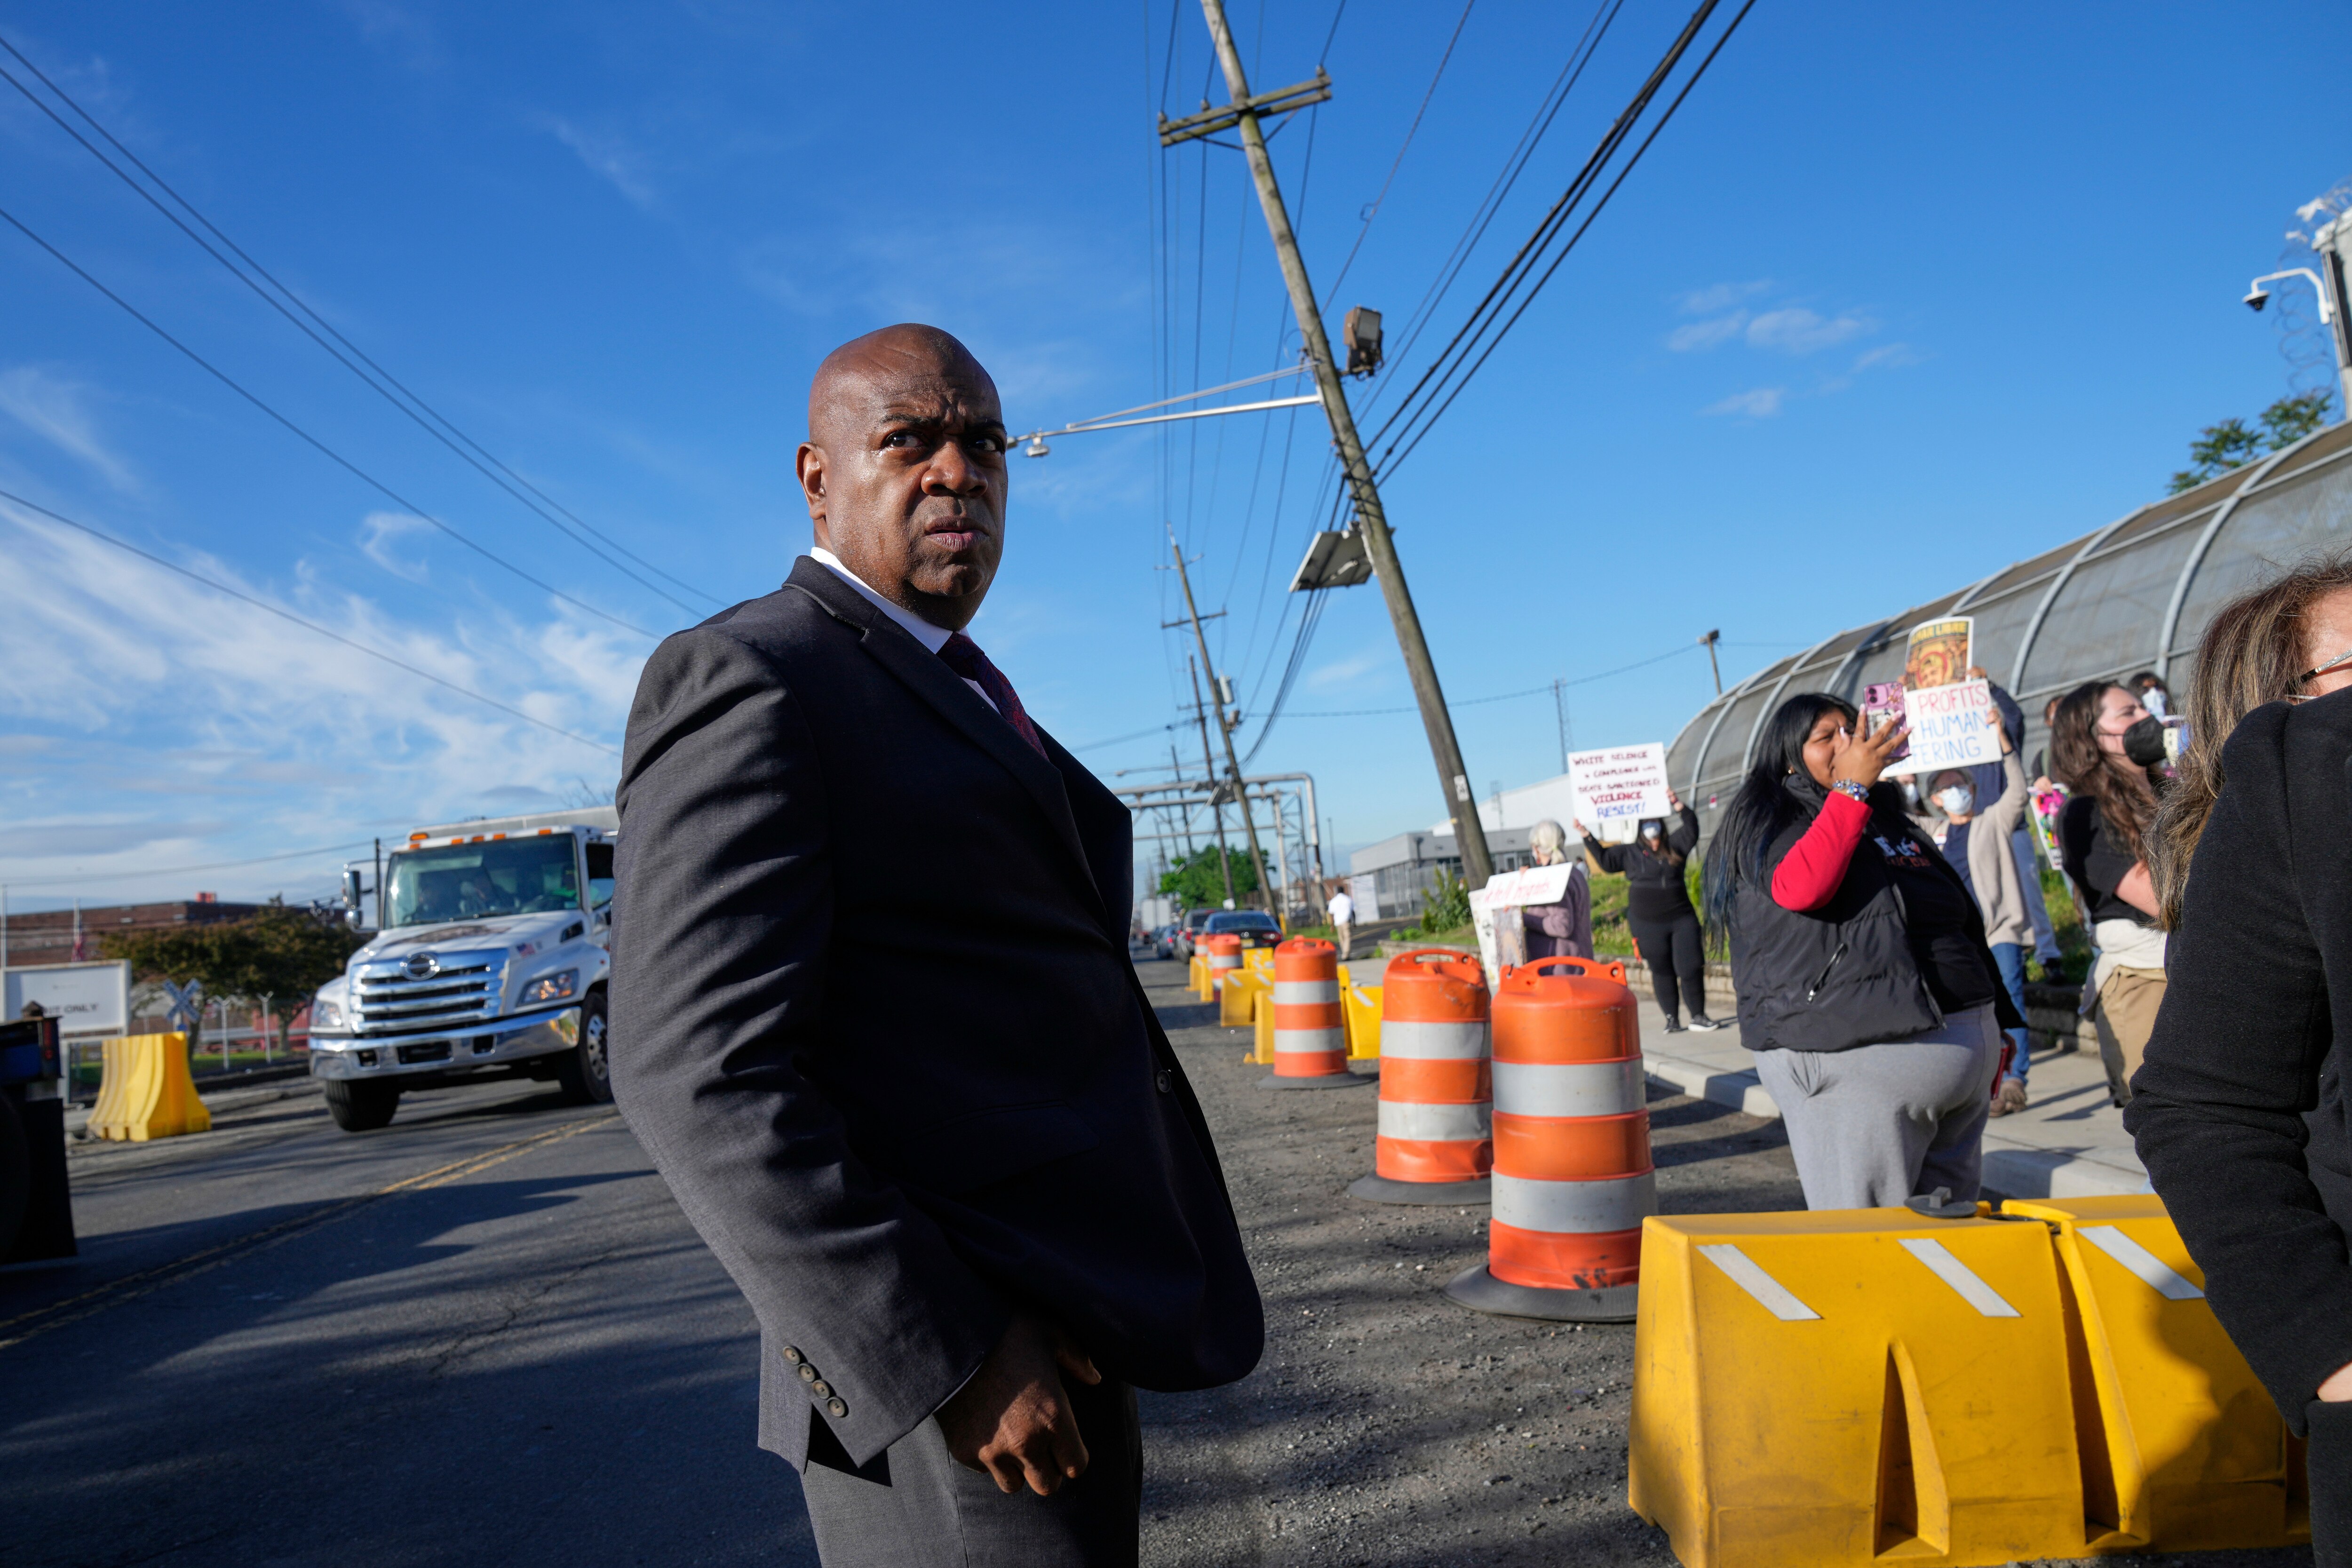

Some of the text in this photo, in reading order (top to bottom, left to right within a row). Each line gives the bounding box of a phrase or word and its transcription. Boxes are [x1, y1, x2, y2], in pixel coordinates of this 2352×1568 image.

[1918, 684, 1988, 715] PROFITS
[1920, 709, 1990, 740] HUMAN
[1573, 750, 1647, 766] WHITE SILENCE
[1591, 791, 1643, 805] VIOLENCE
[1597, 802, 1645, 818] RESIST!
[64, 1002, 99, 1014] ONLY
